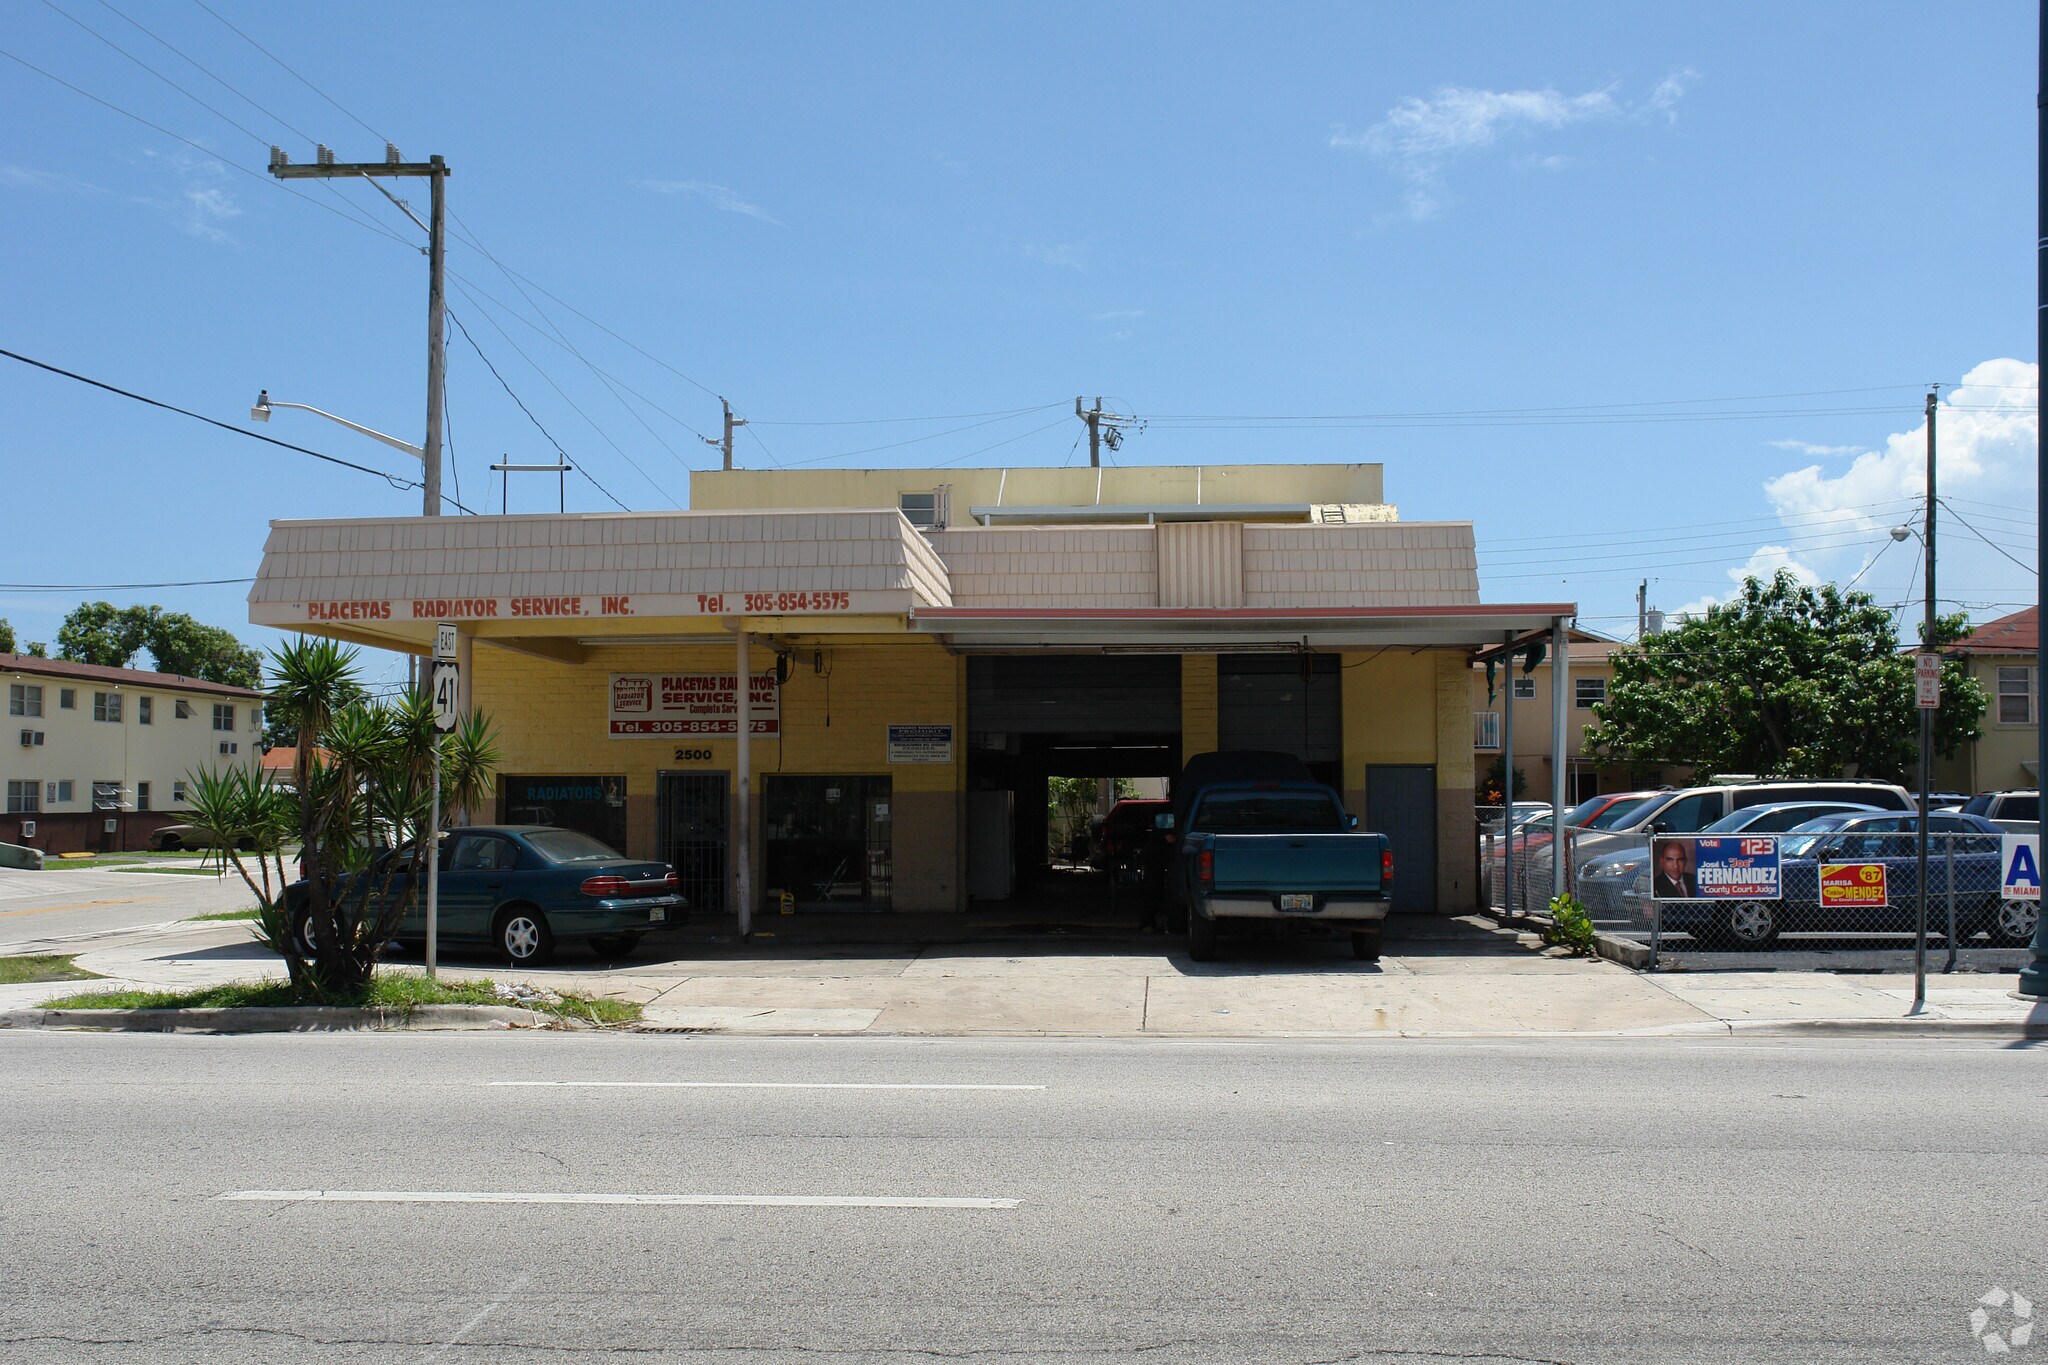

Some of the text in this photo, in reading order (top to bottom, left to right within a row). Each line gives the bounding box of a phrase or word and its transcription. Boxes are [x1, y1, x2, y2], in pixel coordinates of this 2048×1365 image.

[308, 601, 392, 620] PLACETAS
[412, 598, 498, 619] RADIATOR
[601, 596, 635, 616] INC.
[697, 594, 731, 613] Tel.
[744, 592, 850, 612] 305-854-5575
[440, 631, 455, 651] EAST
[1923, 657, 1933, 668] NO
[1917, 668, 1938, 679] PARKING
[661, 676, 716, 691] PLACETAS
[437, 677, 454, 714] 41
[617, 692, 645, 700] RADIATOR
[661, 692, 776, 705] SERVICE, NC.
[619, 699, 642, 707] SERVICE
[689, 704, 720, 715] Complete
[616, 721, 767, 733] Tel. 305-854-575
[675, 749, 712, 760] 2500
[527, 785, 602, 801] RADIATORS
[1699, 839, 1719, 847] Vote
[1741, 838, 1775, 855] #123
[1701, 860, 1720, 868] José
[1697, 867, 1778, 885] FERNANDEZ
[1823, 867, 1836, 876] Vote
[1704, 885, 1731, 895] County
[1732, 885, 1753, 893] Court
[1754, 886, 1777, 894] Judge
[1845, 886, 1884, 899] MENDEZ
[2013, 887, 2040, 896] MIAMI
